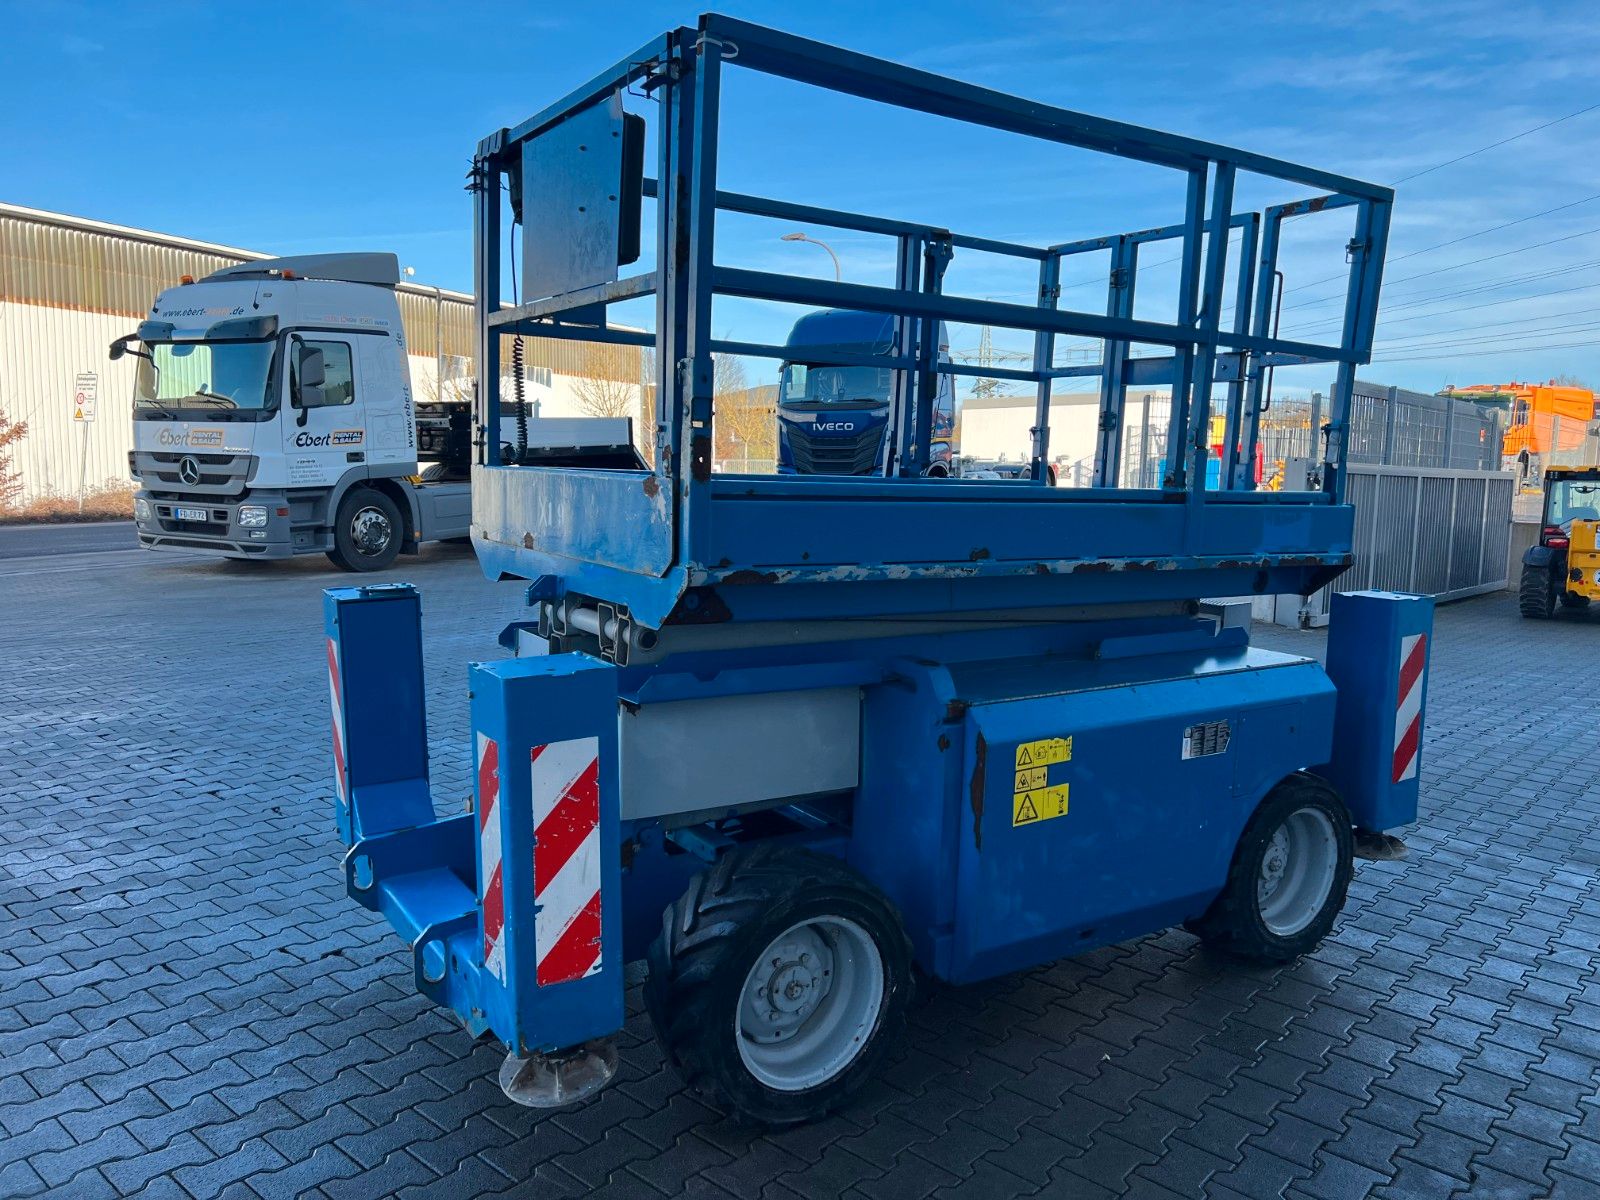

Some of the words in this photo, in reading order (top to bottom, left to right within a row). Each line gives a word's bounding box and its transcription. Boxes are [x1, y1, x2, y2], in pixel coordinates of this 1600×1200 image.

[812, 422, 854, 431] IVECO
[160, 428, 191, 446] Ebert
[296, 431, 331, 447] Ebert
